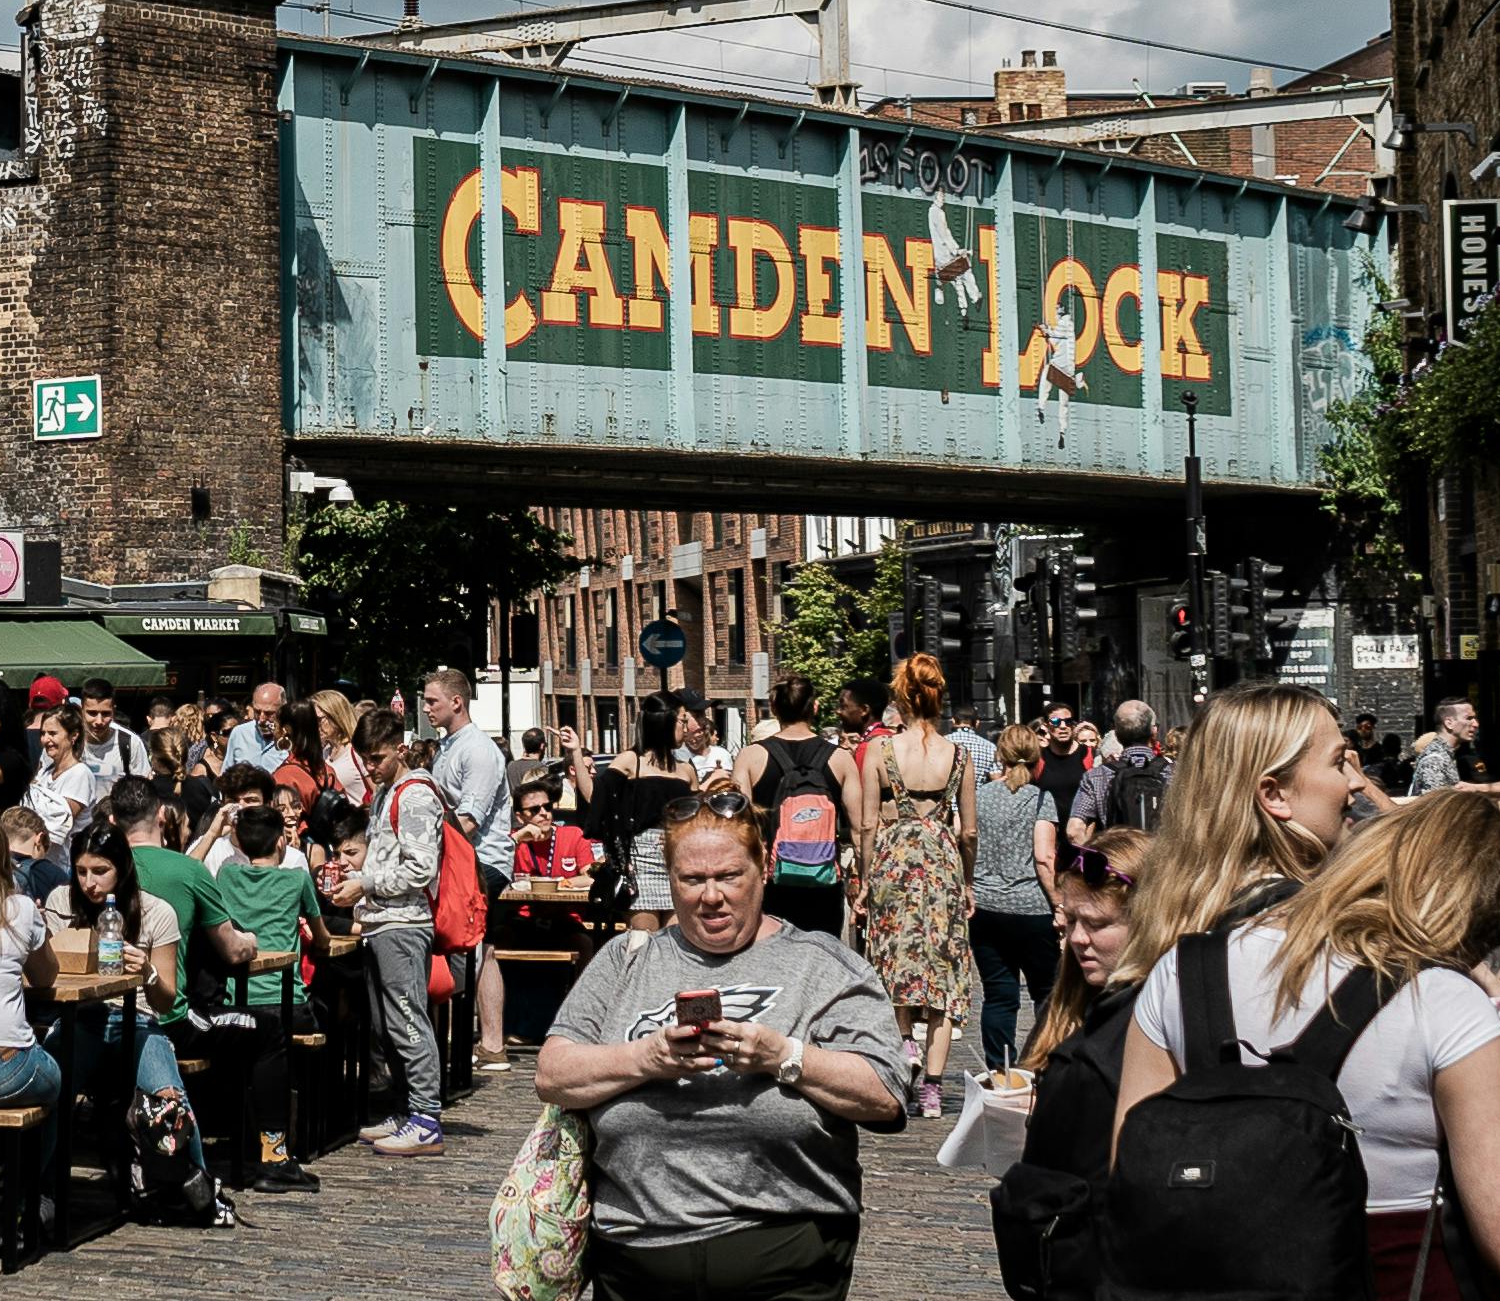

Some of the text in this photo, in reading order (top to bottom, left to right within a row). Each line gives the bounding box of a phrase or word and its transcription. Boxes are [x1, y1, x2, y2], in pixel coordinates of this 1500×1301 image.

[1461, 215, 1488, 313] HONES
[442, 166, 934, 355] CAMDEN
[980, 224, 1212, 390] LOCK
[142, 618, 240, 631] CAMDEN MARKET
[218, 675, 247, 685] COFFEE
[406, 1023, 422, 1044] RIP
